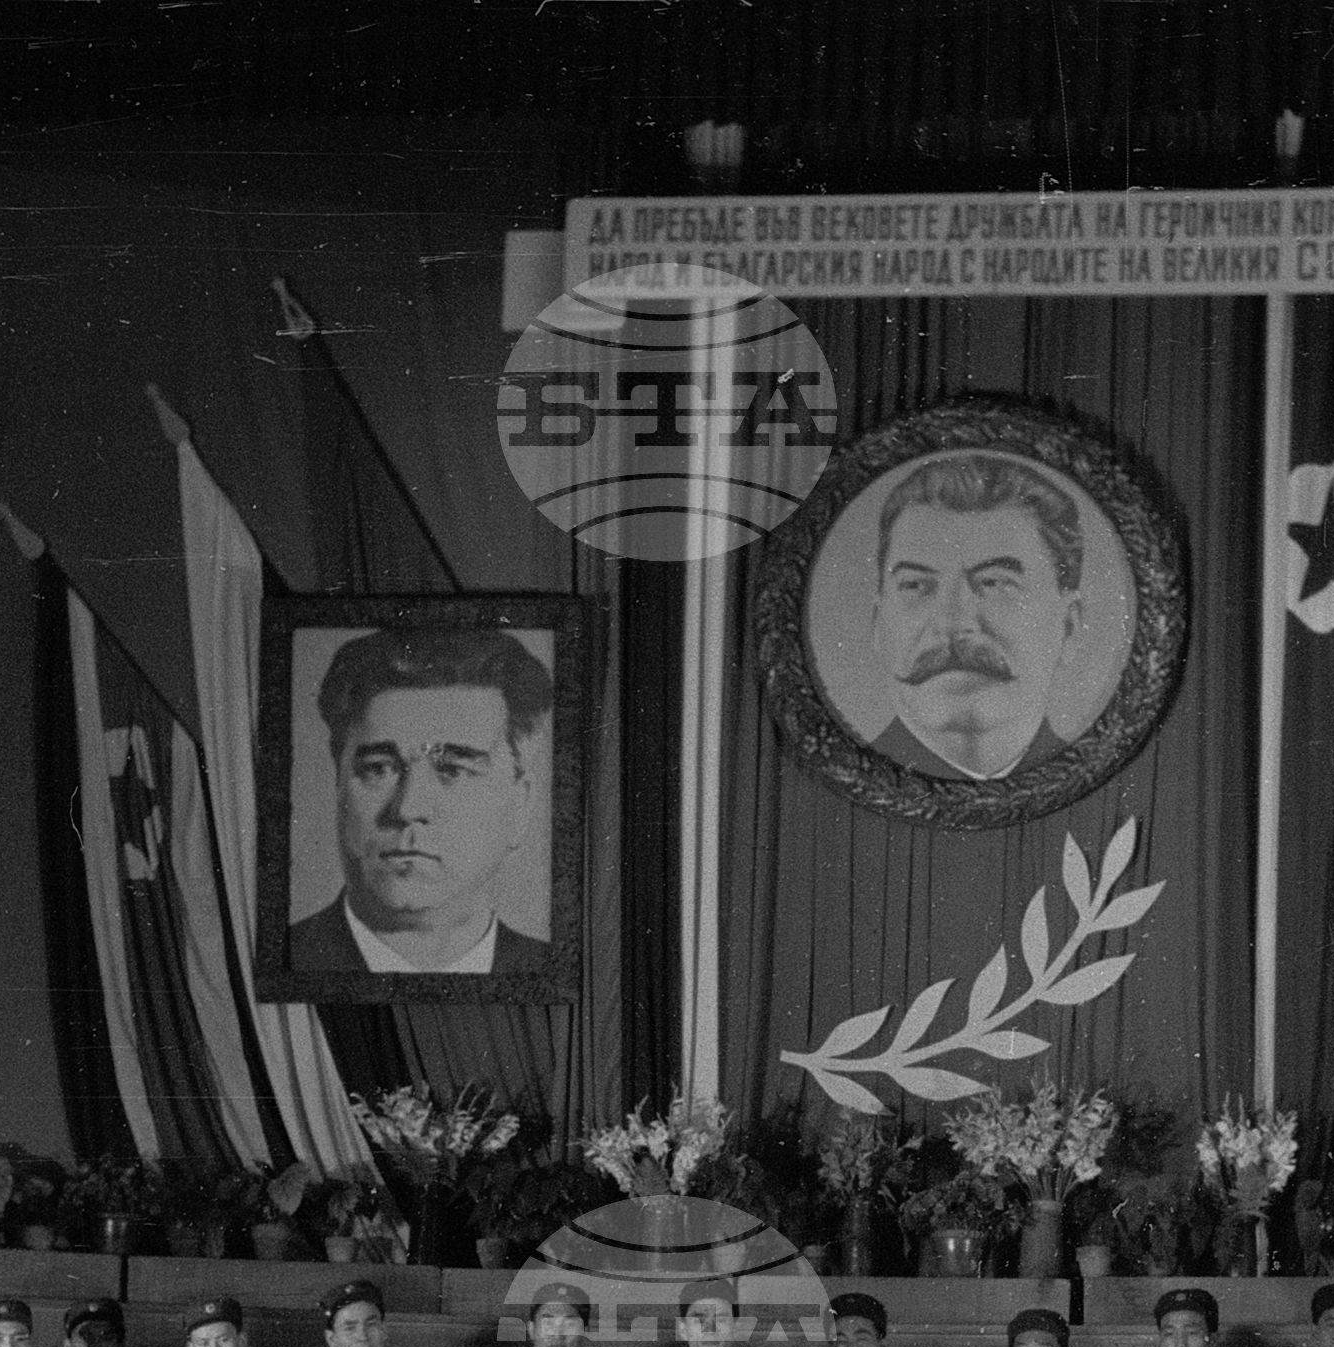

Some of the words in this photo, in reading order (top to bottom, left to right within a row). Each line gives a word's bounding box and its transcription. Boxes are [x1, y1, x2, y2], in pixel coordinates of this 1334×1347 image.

[588, 206, 625, 246] ДА
[633, 205, 746, 246] ПРЕБЪДЕ
[755, 205, 800, 242] ВЪВ
[811, 203, 940, 242] ВЕКОВЕТЕ
[946, 201, 1085, 243] ДРУЖБАТА
[1095, 201, 1128, 239] НА
[1139, 199, 1282, 239] ГЕРОИЧНИЯ
[588, 250, 666, 289] НАРОД
[674, 249, 691, 287] И
[702, 248, 862, 287] БЪЛГАРСКИЯ
[872, 247, 953, 286] НАРОД
[960, 247, 976, 284] С
[983, 247, 1109, 286] НАРОДИТЕ
[1118, 246, 1152, 283] НА
[1163, 245, 1280, 283] ВЕЛИКИЯ
